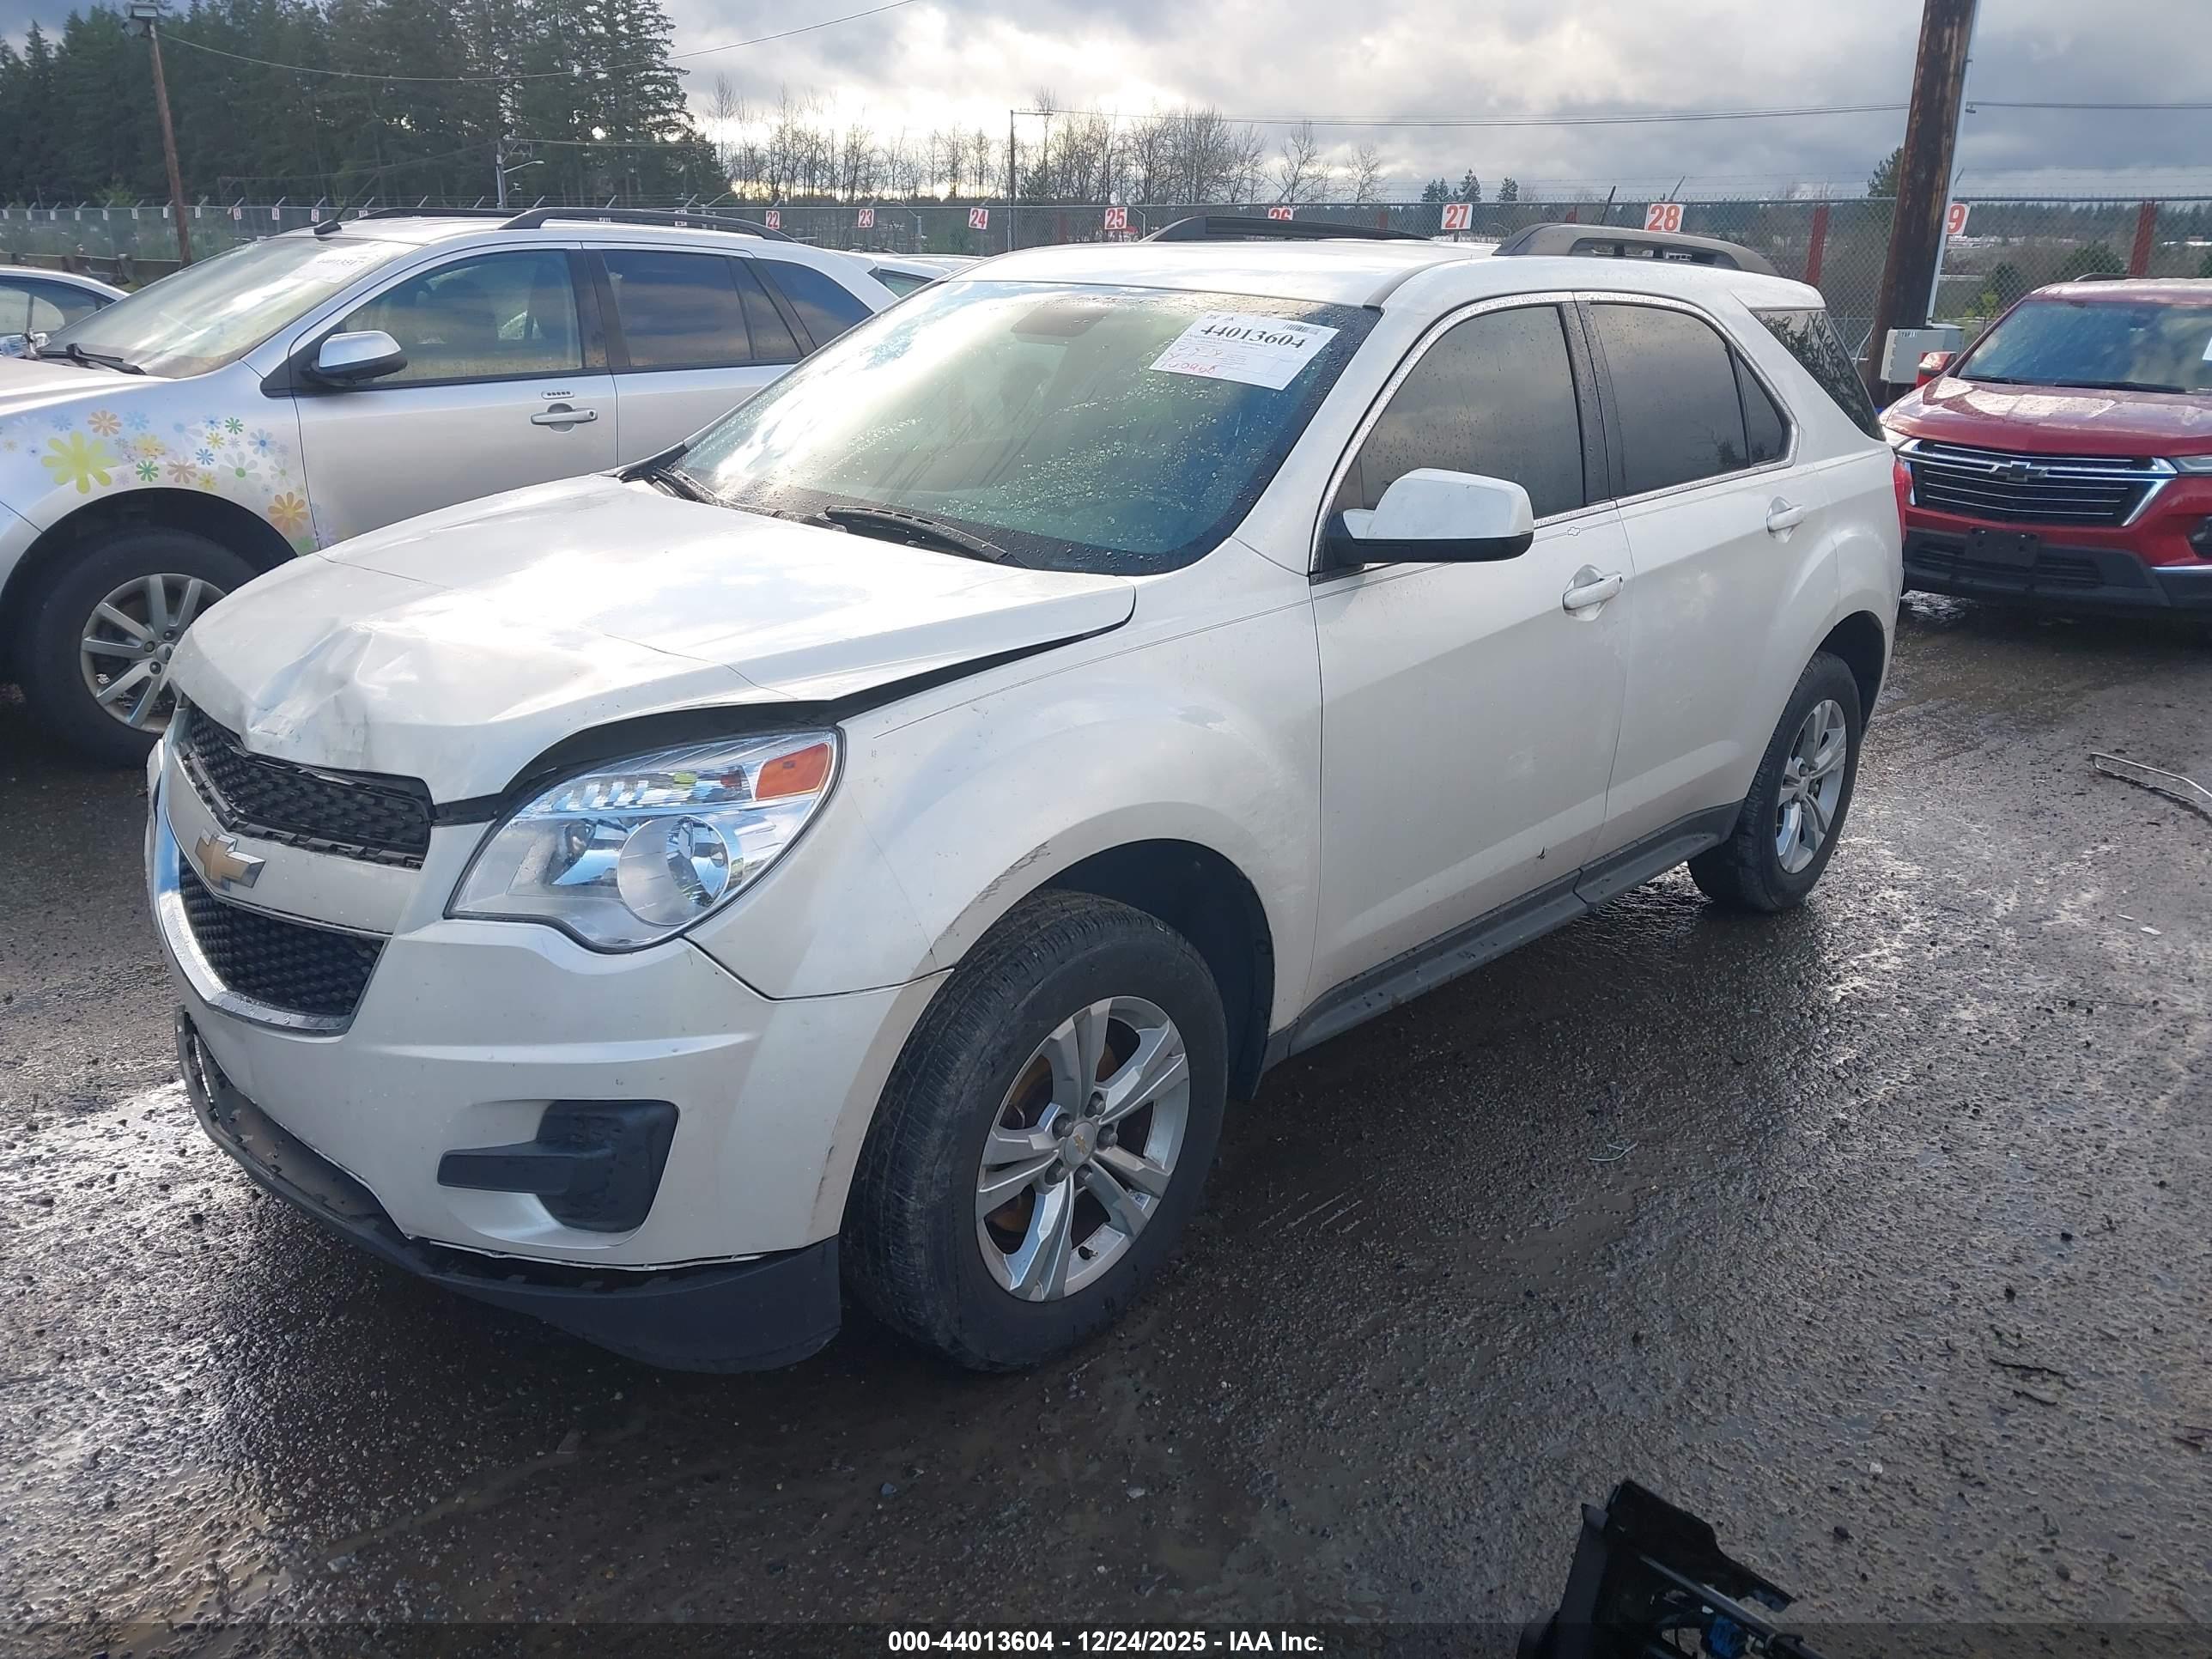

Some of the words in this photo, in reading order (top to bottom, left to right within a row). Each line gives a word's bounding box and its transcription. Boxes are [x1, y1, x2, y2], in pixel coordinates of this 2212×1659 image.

[767, 211, 778, 228] 22
[859, 210, 873, 227] 23
[969, 209, 987, 228] 24
[1105, 208, 1126, 228] 25
[1444, 205, 1469, 228] 27
[1647, 204, 1680, 231] 28
[1200, 325, 1306, 349] 44013604
